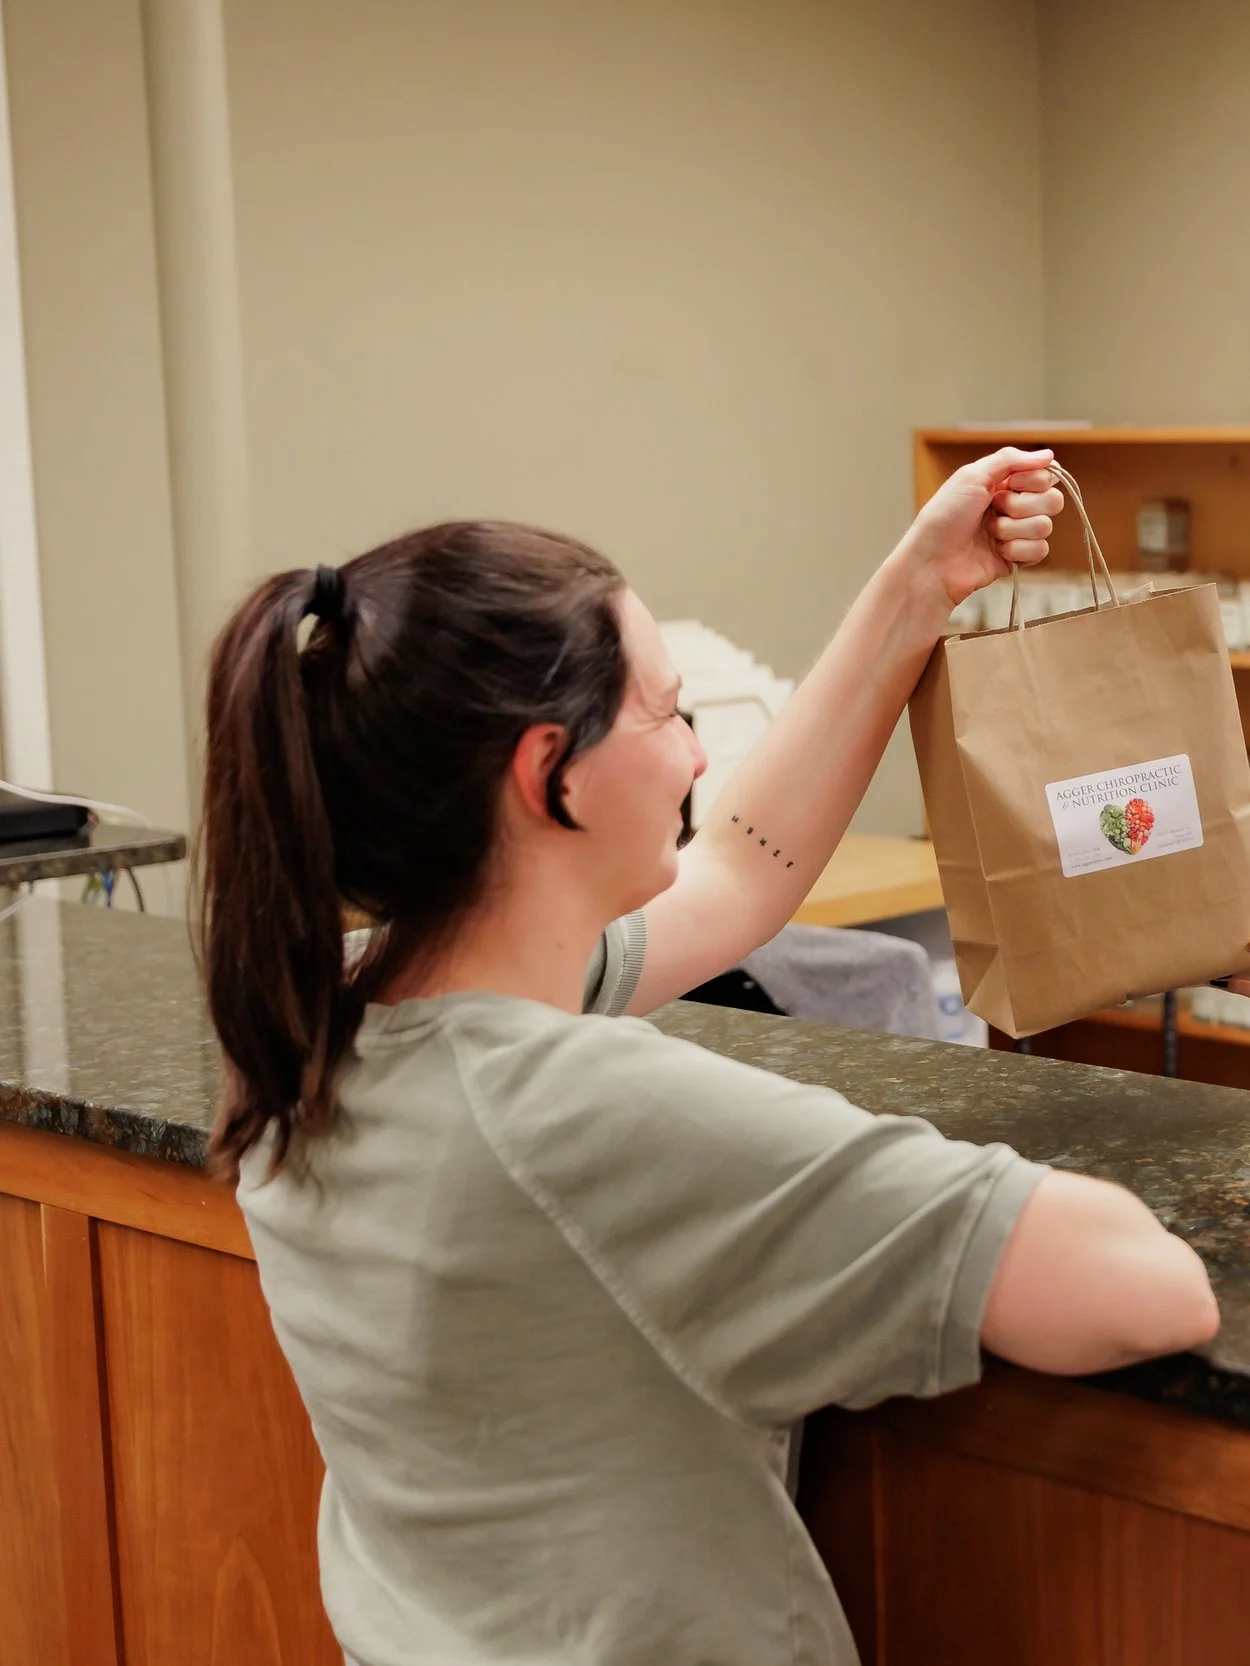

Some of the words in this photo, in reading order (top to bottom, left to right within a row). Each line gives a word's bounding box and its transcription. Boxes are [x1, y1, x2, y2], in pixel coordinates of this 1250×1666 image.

[1056, 784, 1096, 801] AGGER
[1096, 764, 1182, 792] CHIROPRACTIC
[1062, 801, 1070, 810] &
[1072, 785, 1137, 808] NUTRITION
[1139, 775, 1180, 793] CLINIC
